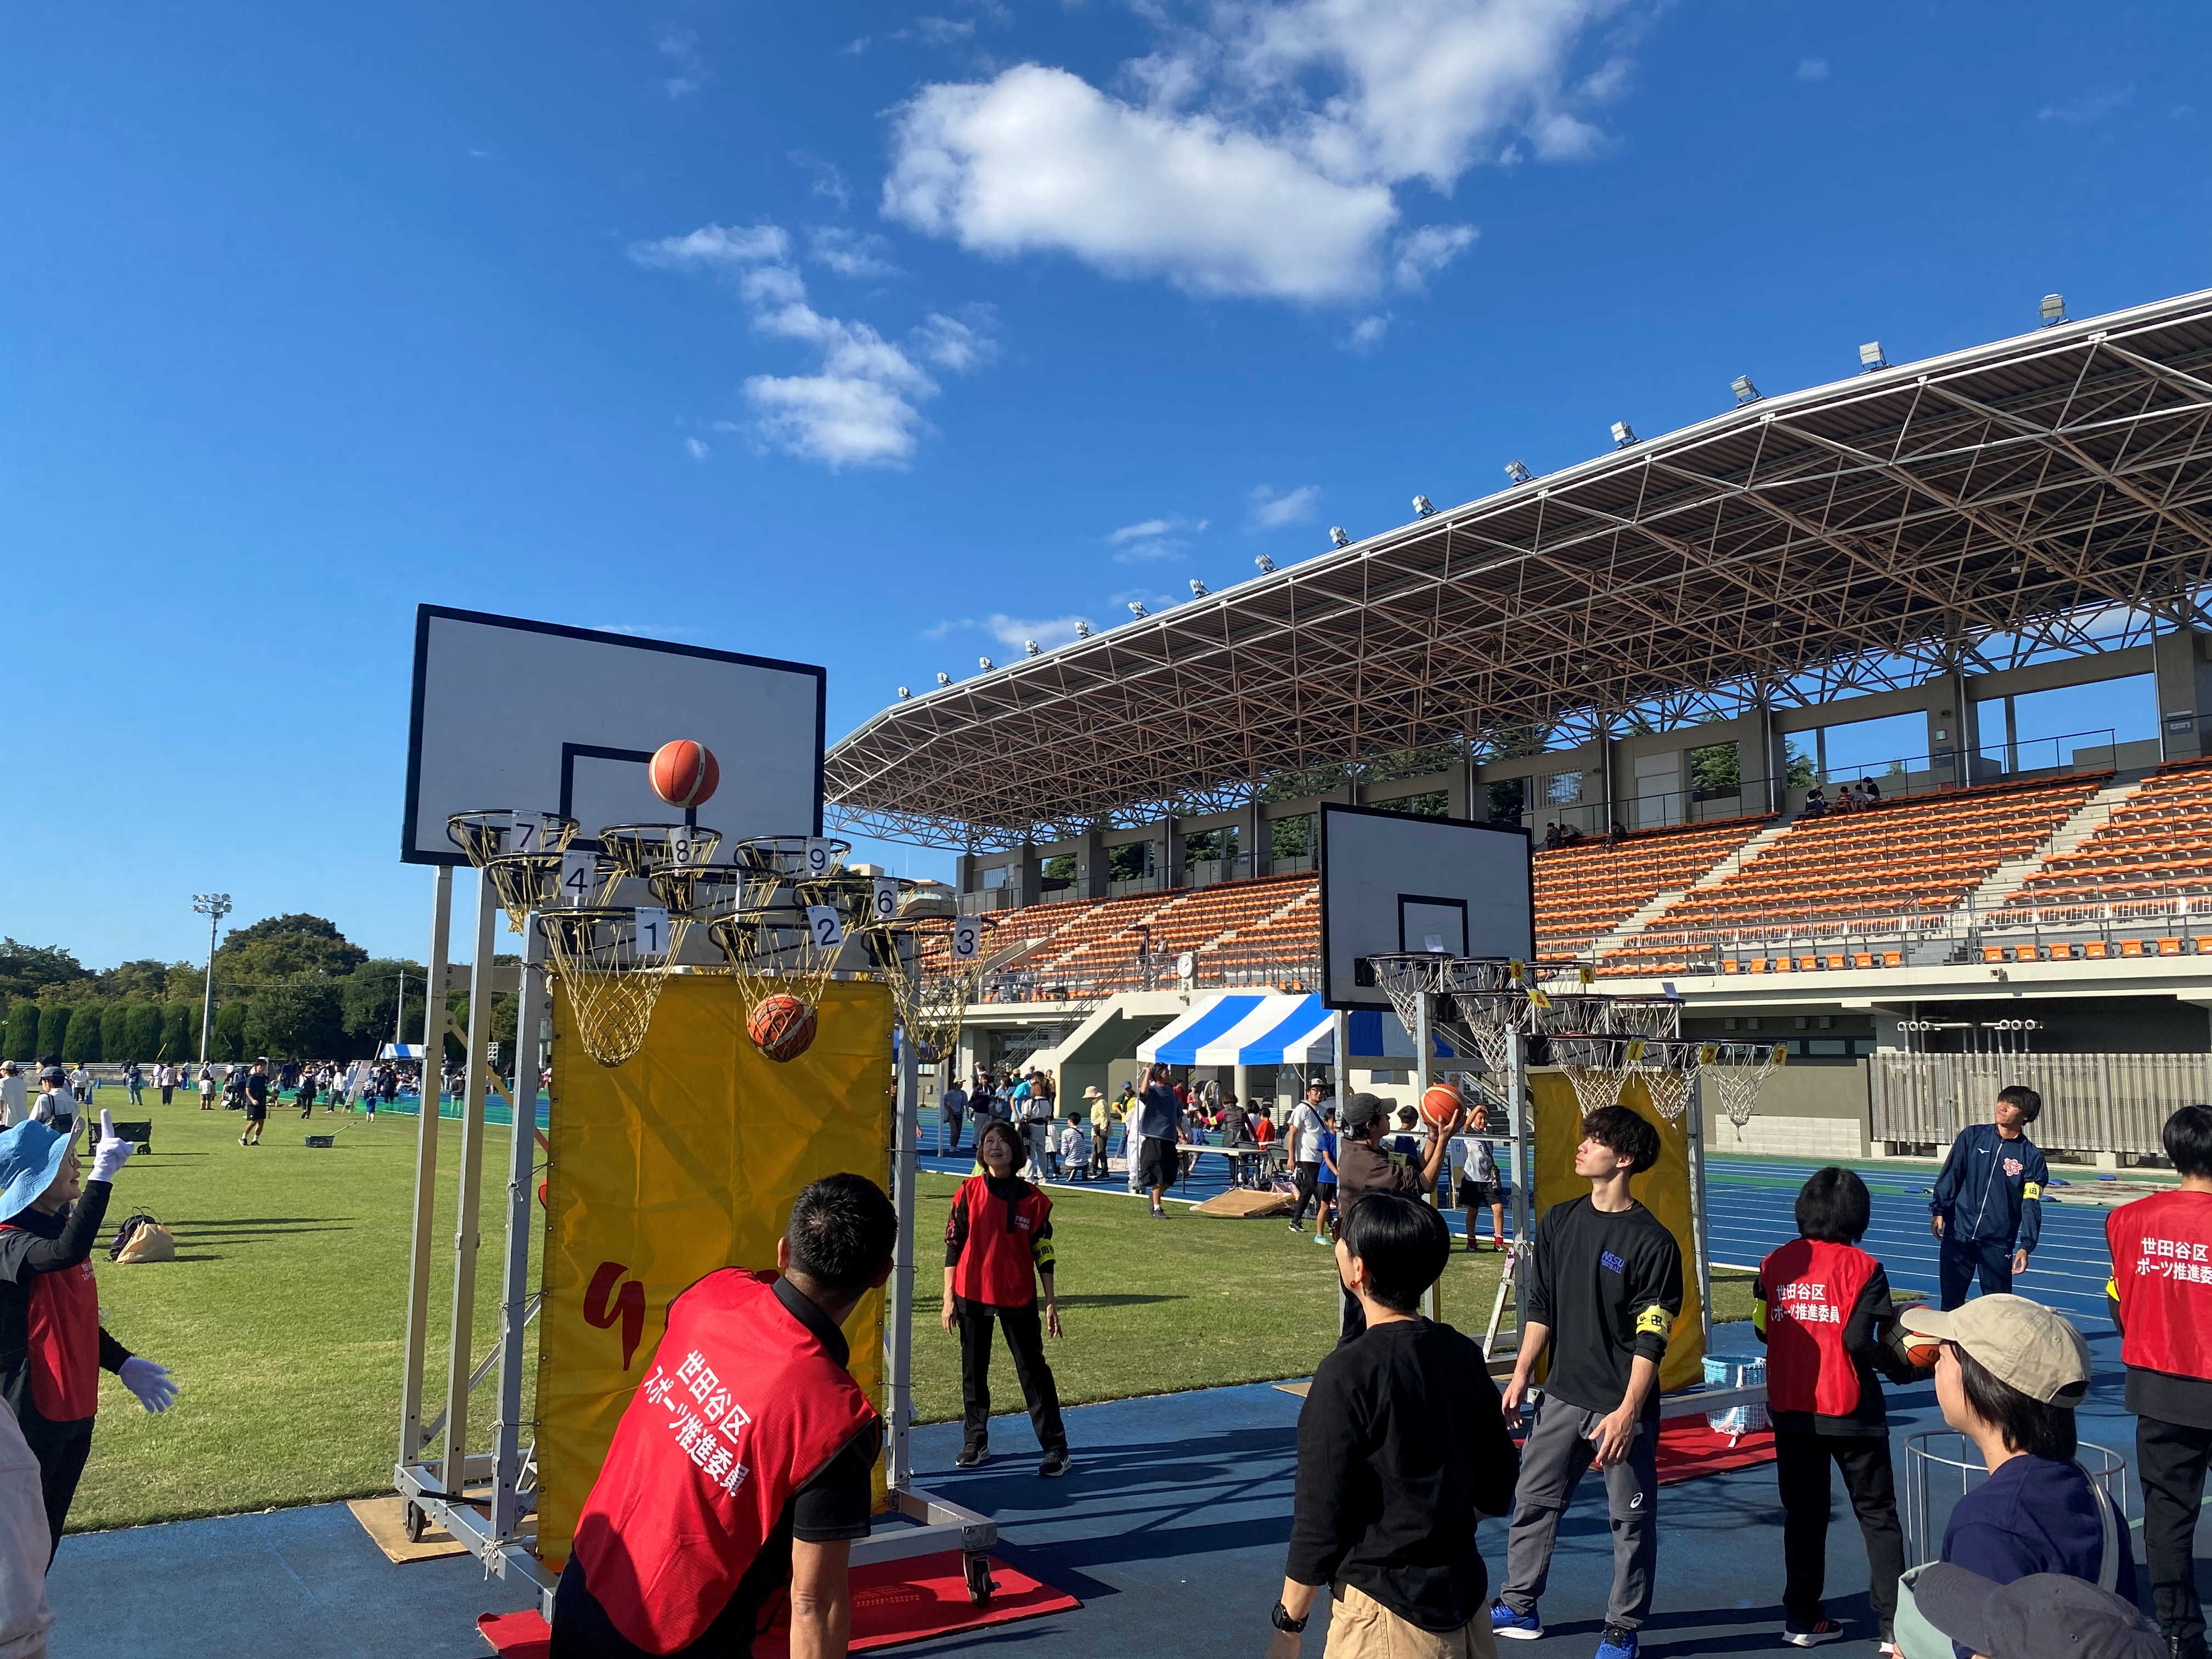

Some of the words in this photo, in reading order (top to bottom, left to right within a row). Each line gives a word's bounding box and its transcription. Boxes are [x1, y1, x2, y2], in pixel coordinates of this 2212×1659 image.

[516, 823, 535, 848] 7
[676, 839, 690, 862] 8
[810, 848, 825, 870] 9
[566, 868, 588, 894] 4
[878, 890, 893, 913] 6
[644, 922, 656, 951] 1
[817, 918, 839, 945] 2
[957, 929, 974, 955] 3
[1515, 964, 1521, 977] 8
[1584, 969, 1590, 981] 9
[1632, 1044, 1640, 1058] 1
[1706, 1048, 1715, 1063] 2
[1775, 1049, 1784, 1063] 3
[1602, 1251, 1624, 1267] NSSU
[2141, 1237, 2209, 1262] 世田谷区
[2135, 1257, 2212, 1285] ポーツ推進委
[1776, 1283, 1826, 1301] 世田谷区
[675, 1350, 752, 1445] 世田谷区
[644, 1364, 750, 1497] スポーツ推進委員
